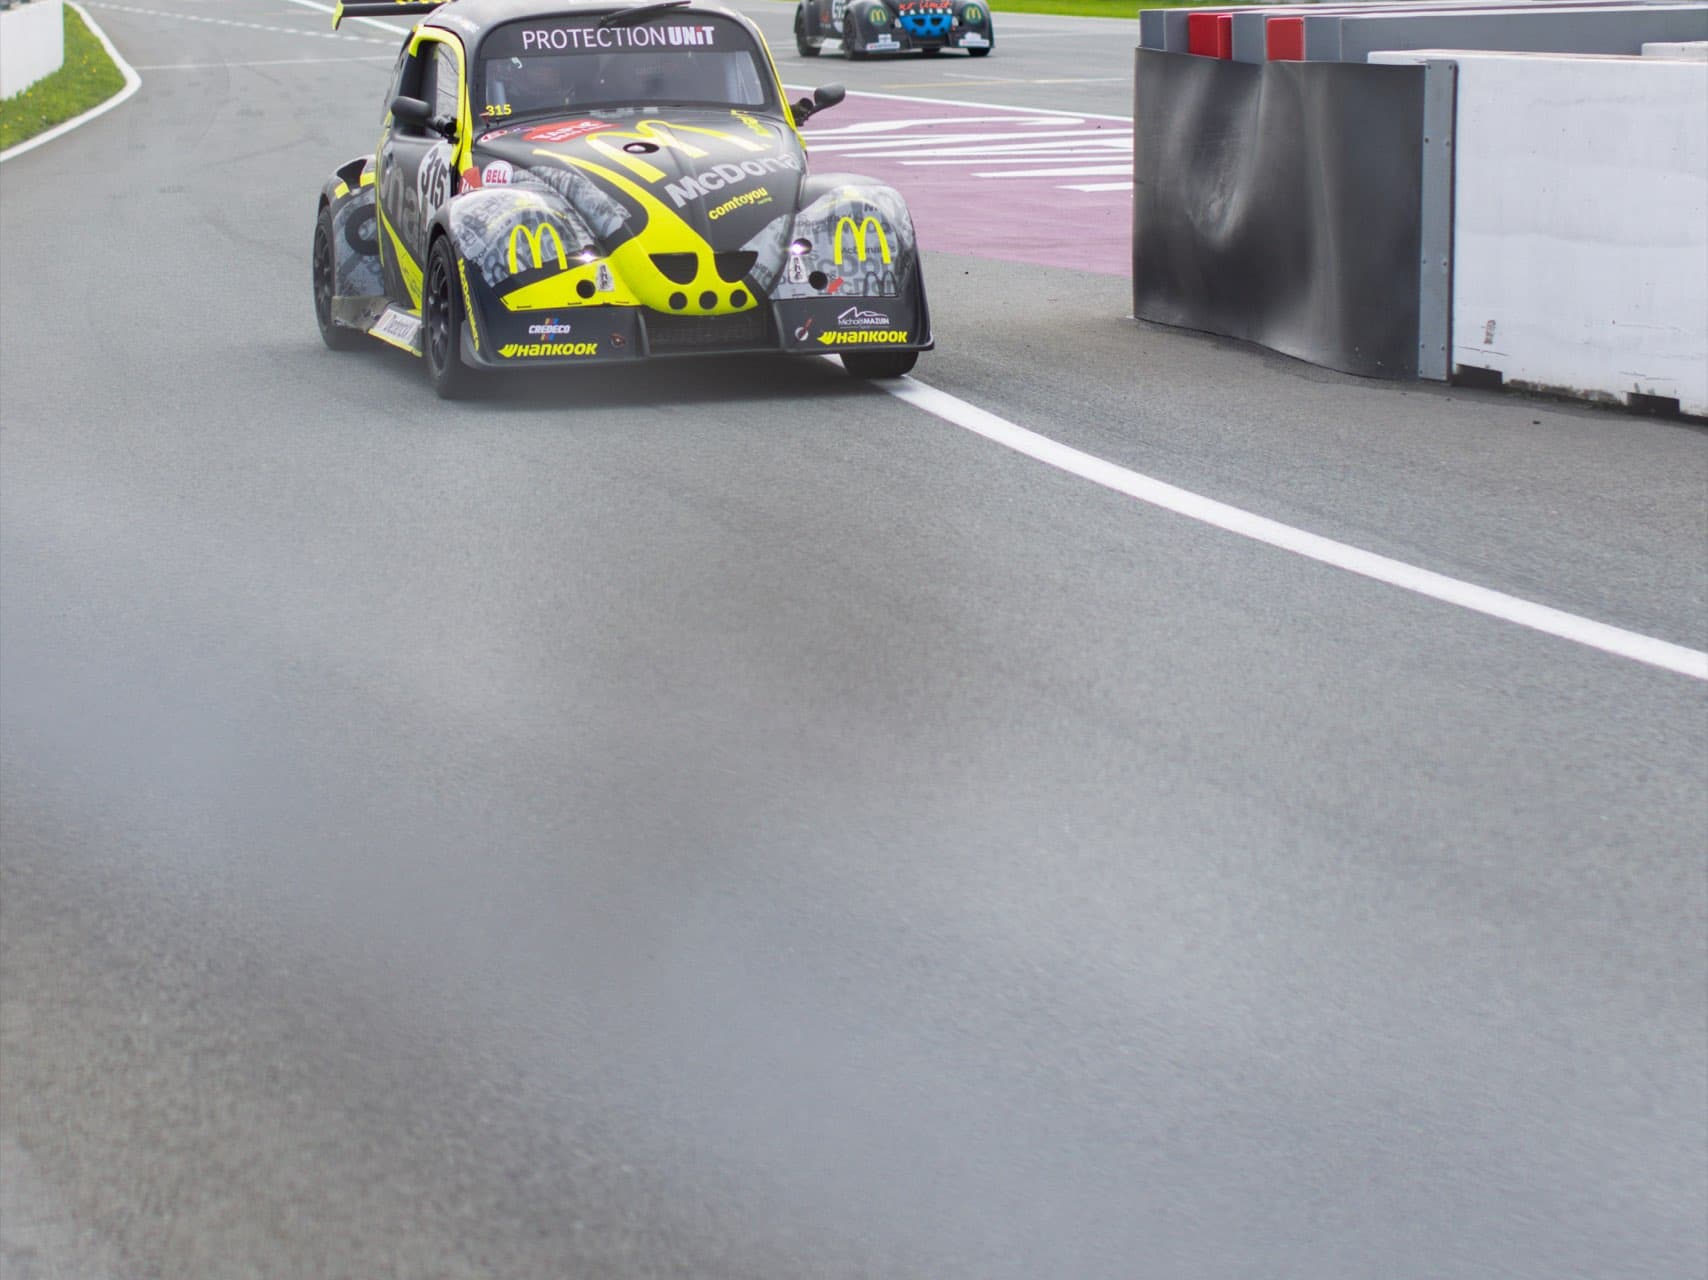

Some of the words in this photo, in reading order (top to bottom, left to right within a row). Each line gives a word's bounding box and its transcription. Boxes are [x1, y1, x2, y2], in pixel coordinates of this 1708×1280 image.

[522, 26, 667, 50] PROTECTION
[485, 104, 512, 116] 315
[421, 147, 448, 211] 315
[485, 169, 508, 184] BELL
[708, 186, 768, 220] comtoyou
[528, 324, 572, 334] CREDECO
